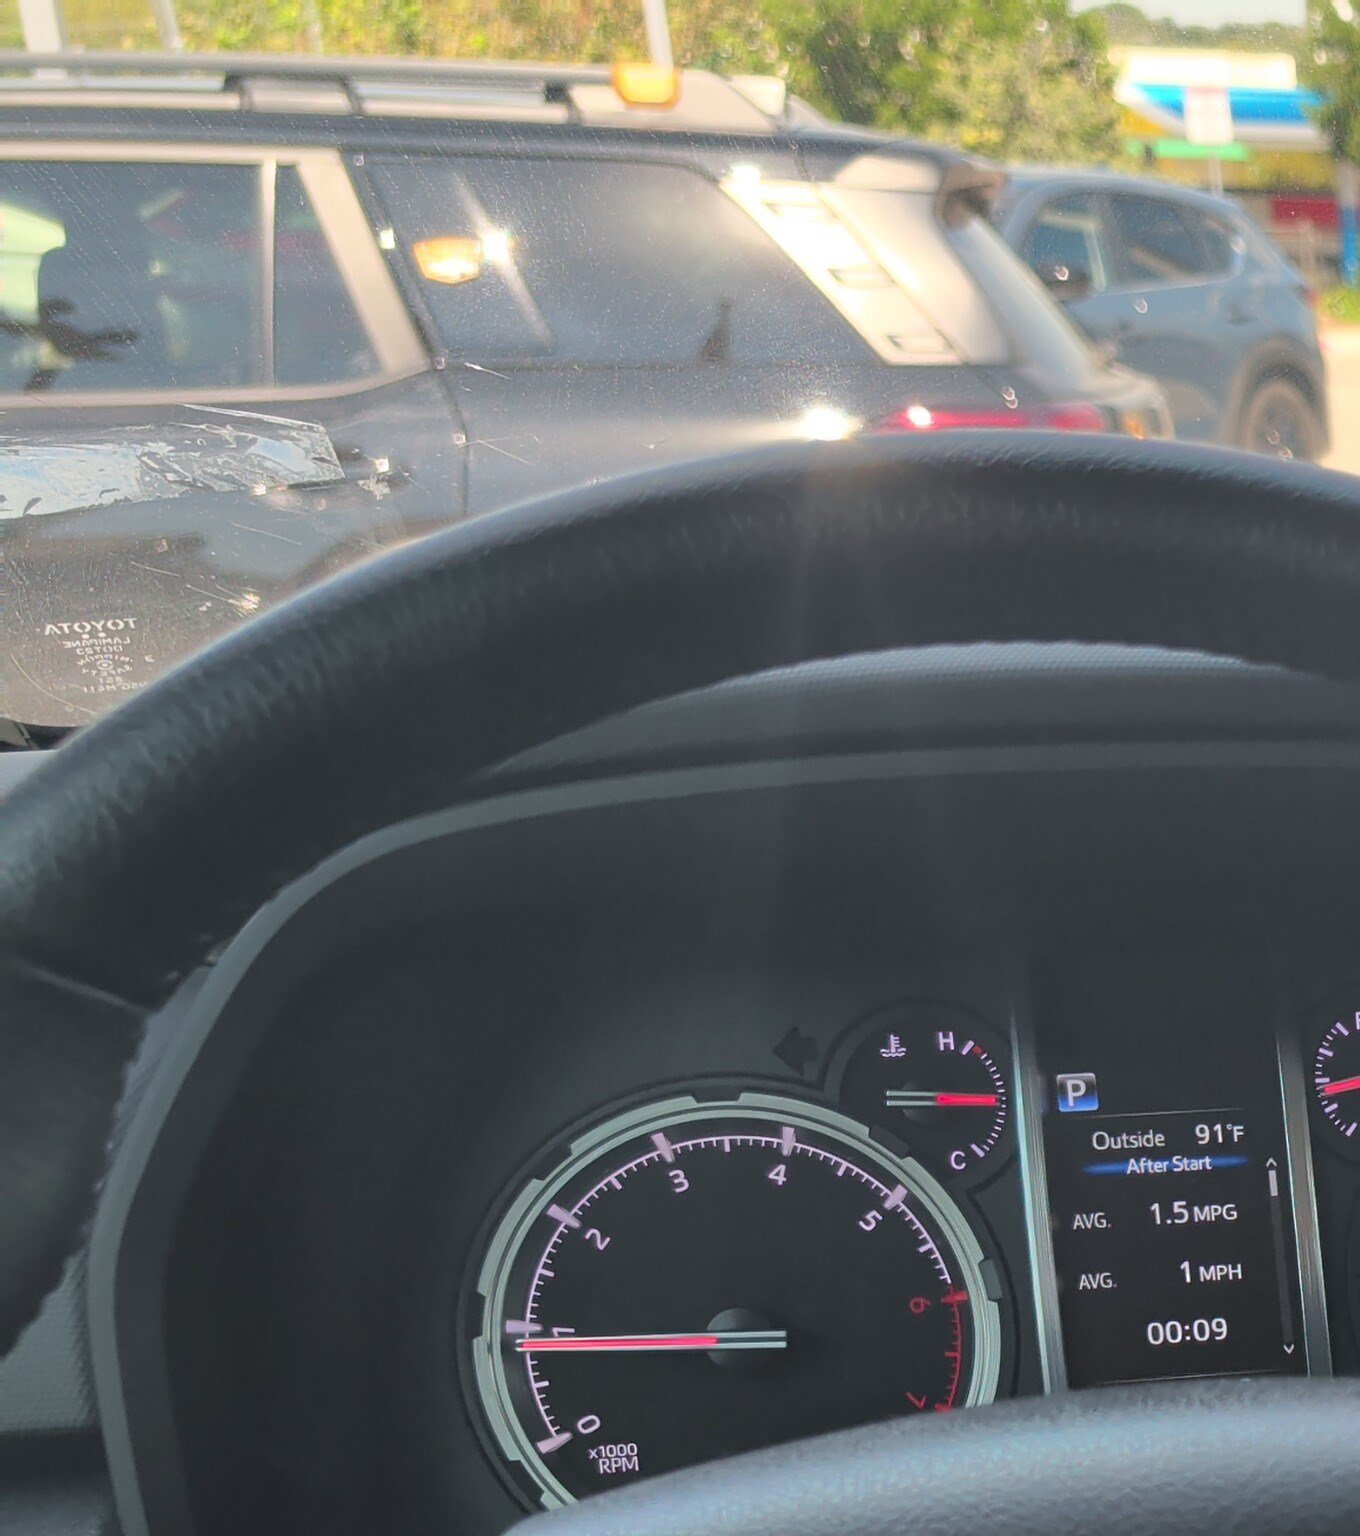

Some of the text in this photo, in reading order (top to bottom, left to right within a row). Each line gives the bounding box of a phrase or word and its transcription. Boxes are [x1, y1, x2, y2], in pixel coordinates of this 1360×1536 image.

[938, 1031, 955, 1051] H
[1066, 1079, 1087, 1107] P
[1092, 1128, 1165, 1151] Outside
[950, 1150, 967, 1171] C
[1126, 1155, 1212, 1176] After Start
[669, 1169, 690, 1193] 3
[768, 1164, 787, 1186] 4
[858, 1209, 883, 1232] 5
[1073, 1200, 1238, 1231] AVG. 1.5 MPG
[585, 1228, 611, 1251] 2
[1079, 1260, 1243, 1291] AVG. 1 MPH
[909, 1296, 932, 1314] 6
[1147, 1317, 1228, 1346] 00:09
[577, 1414, 601, 1434] 0
[588, 1443, 638, 1460] x1000
[599, 1457, 640, 1474] RPM
